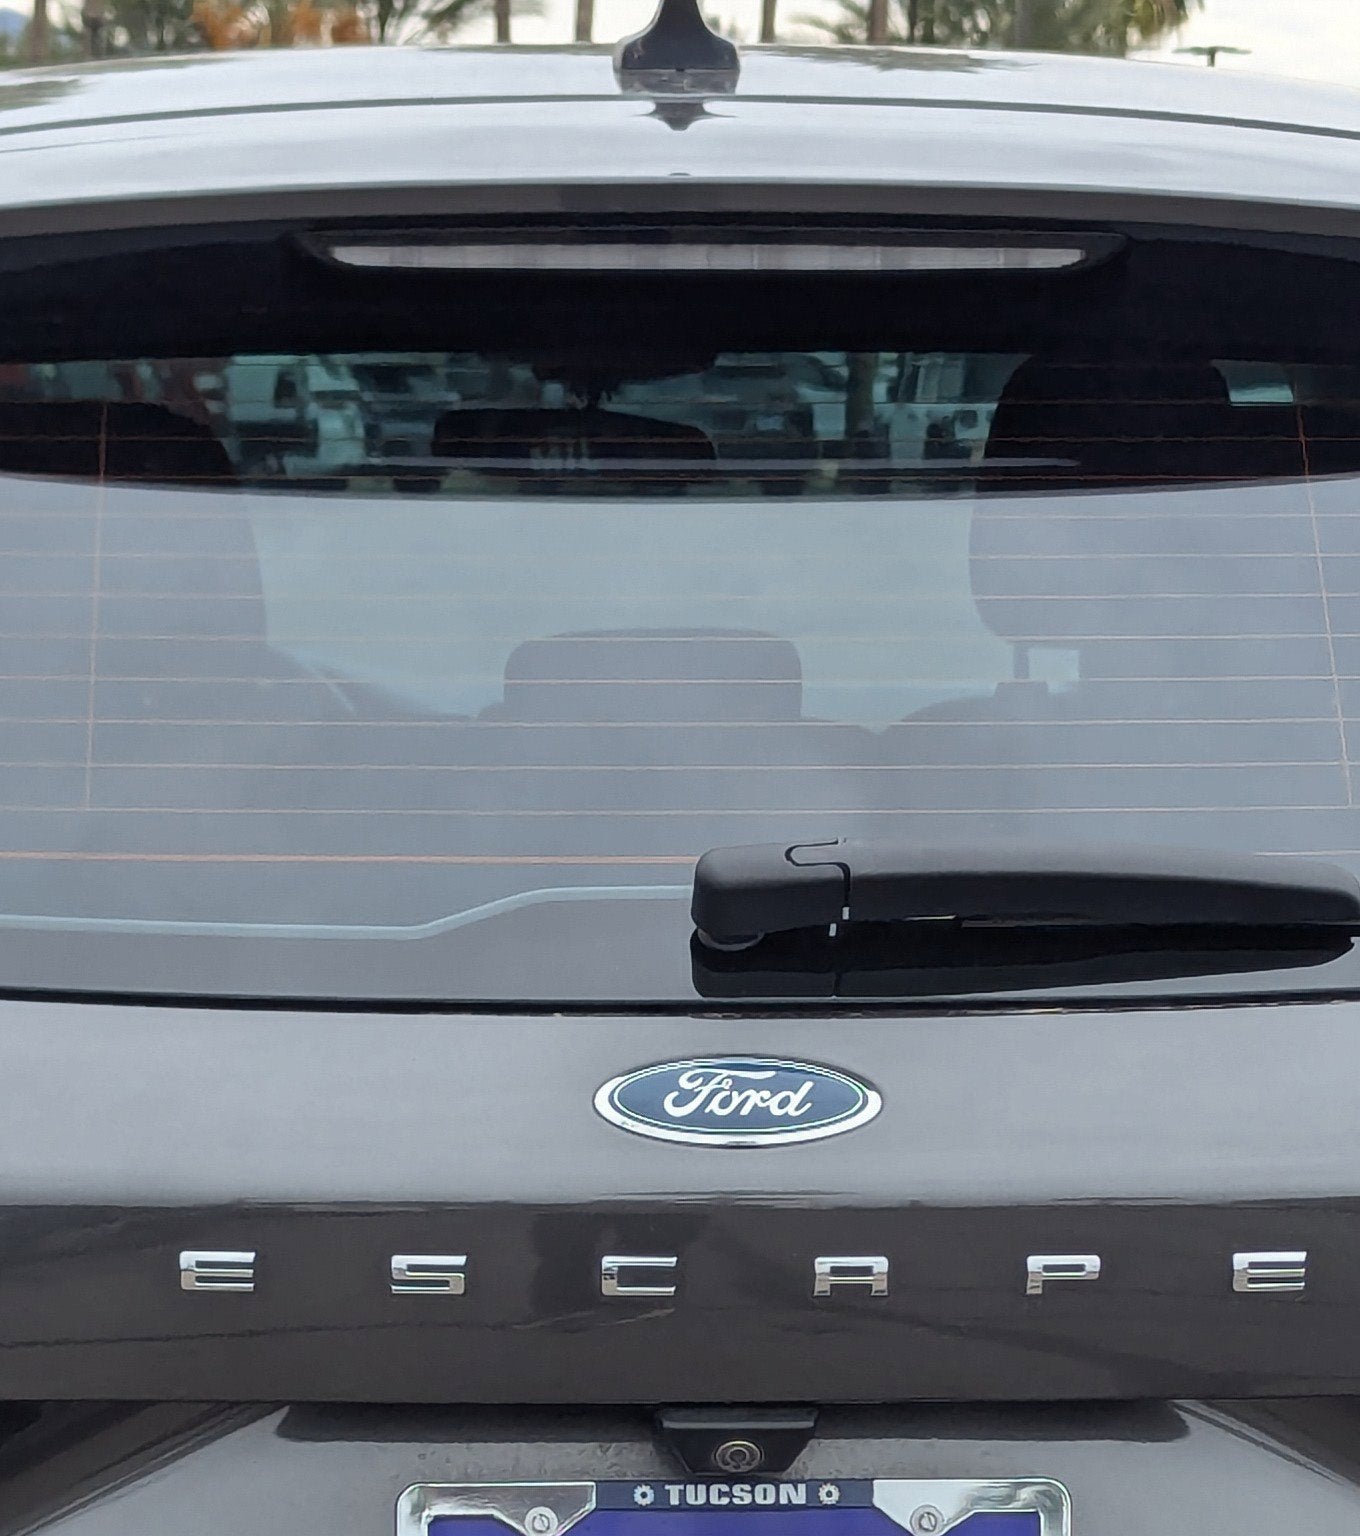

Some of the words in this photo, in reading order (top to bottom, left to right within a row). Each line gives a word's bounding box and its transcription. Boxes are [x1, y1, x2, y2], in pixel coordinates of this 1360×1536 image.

[663, 1068, 815, 1117] Ford
[179, 1250, 1308, 1297] ESCAPE
[664, 1483, 806, 1506] TUCSON
